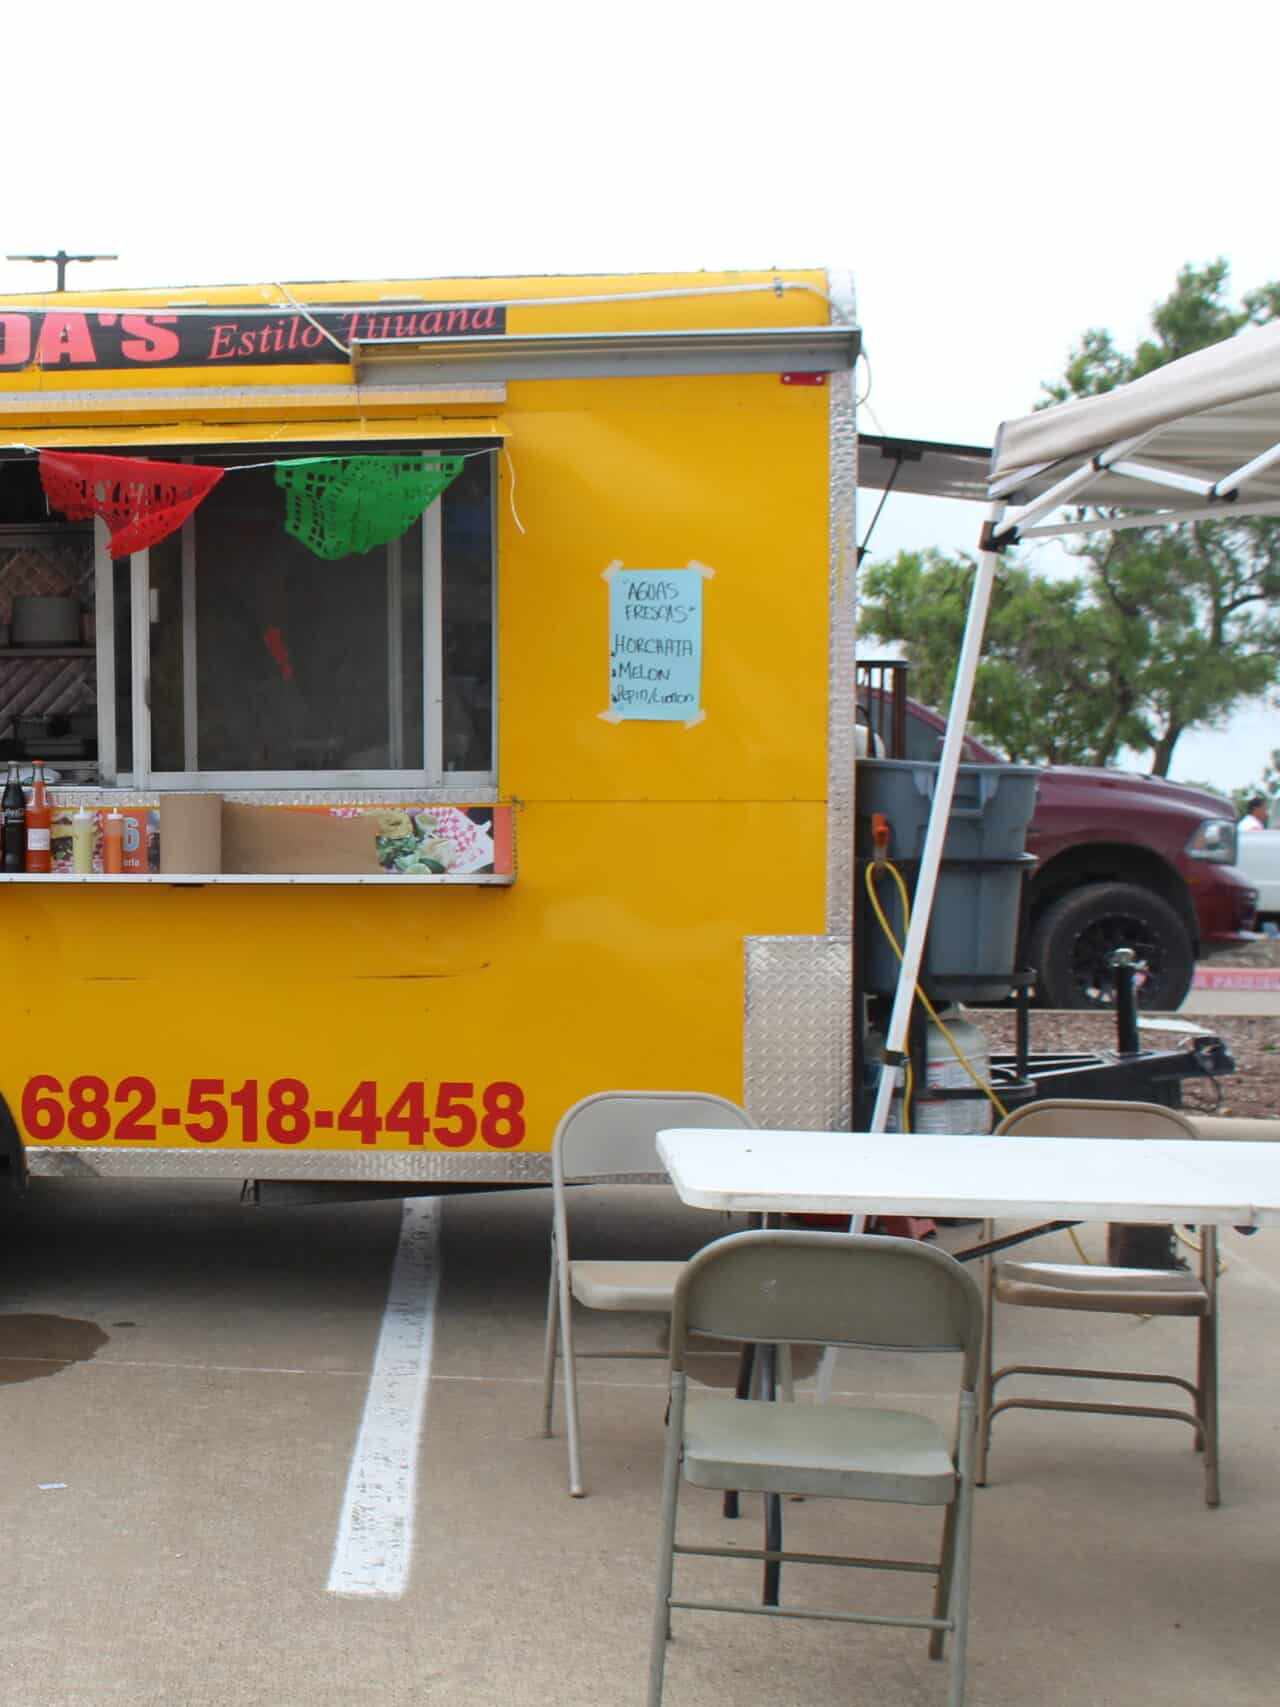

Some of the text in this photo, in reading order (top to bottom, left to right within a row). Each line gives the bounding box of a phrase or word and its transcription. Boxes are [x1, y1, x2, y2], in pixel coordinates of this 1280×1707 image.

[207, 314, 325, 360] Estilo
[122, 816, 141, 852] 6
[21, 1074, 527, 1148] 682-518-4458
